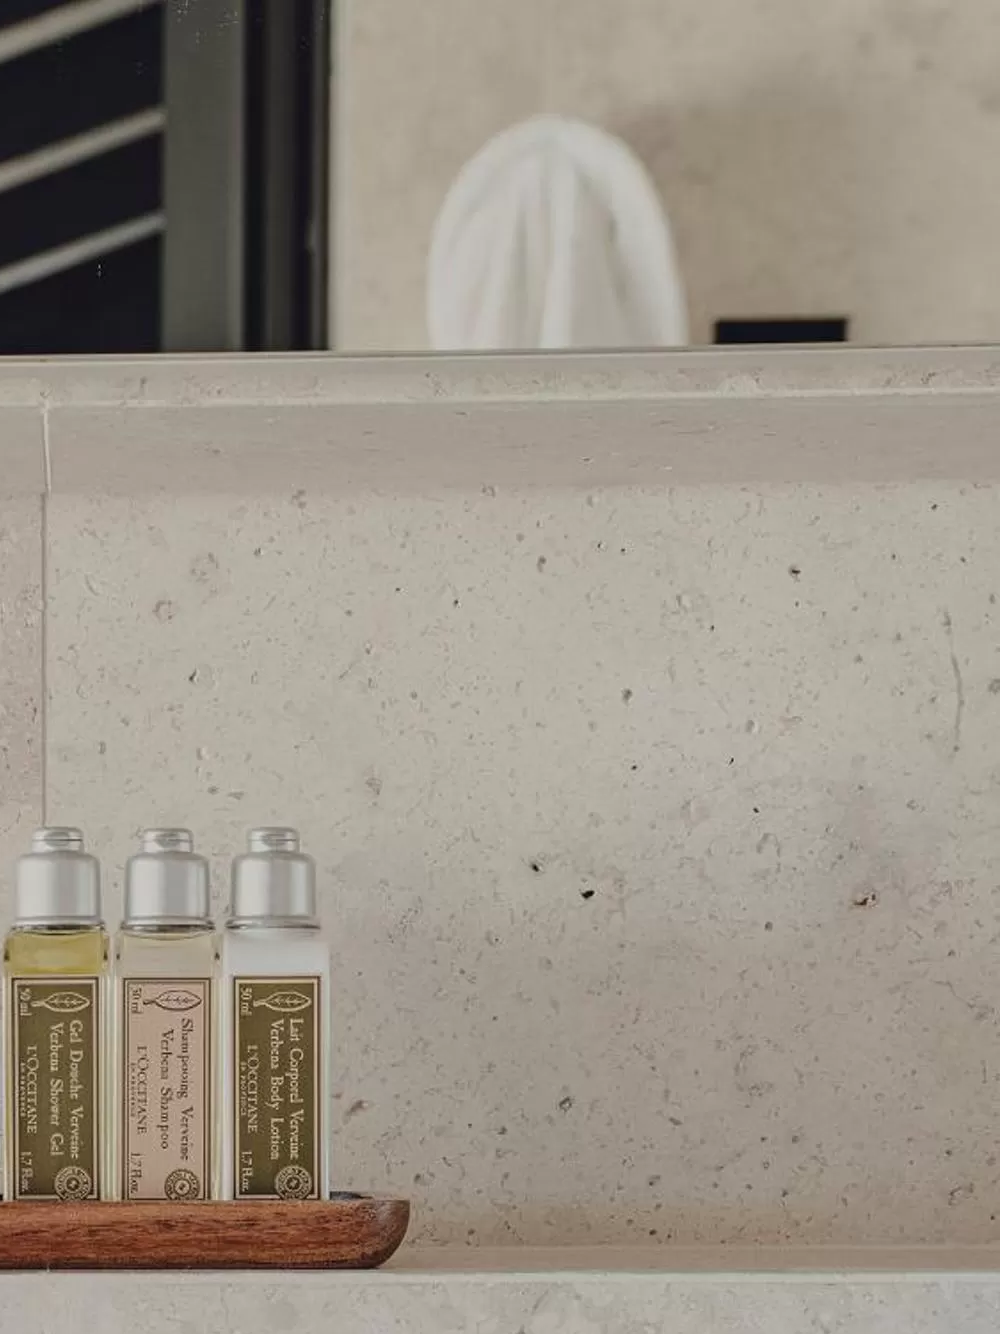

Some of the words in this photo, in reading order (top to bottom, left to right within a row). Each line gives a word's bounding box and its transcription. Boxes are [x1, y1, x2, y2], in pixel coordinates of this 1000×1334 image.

[20, 988, 30, 1000] 50
[131, 988, 142, 1000] 50
[240, 987, 251, 1000] 50
[50, 1022, 64, 1072] Verbena
[70, 1020, 83, 1042] Gel
[160, 1029, 174, 1080] Verbena
[270, 1019, 284, 1069] Verbena
[290, 1018, 304, 1042] Lait
[70, 1050, 83, 1099] Douche
[178, 1018, 194, 1098] Shampooing
[286, 1048, 304, 1103] Corporel
[50, 1078, 64, 1126] Shower
[266, 1076, 284, 1110] Body
[70, 1106, 84, 1159] Verveine
[158, 1087, 174, 1149] Shampoo
[180, 1106, 194, 1160] Verveine
[270, 1118, 284, 1160] Lotion
[290, 1109, 304, 1160] Verveine
[50, 1134, 64, 1156] Gel
